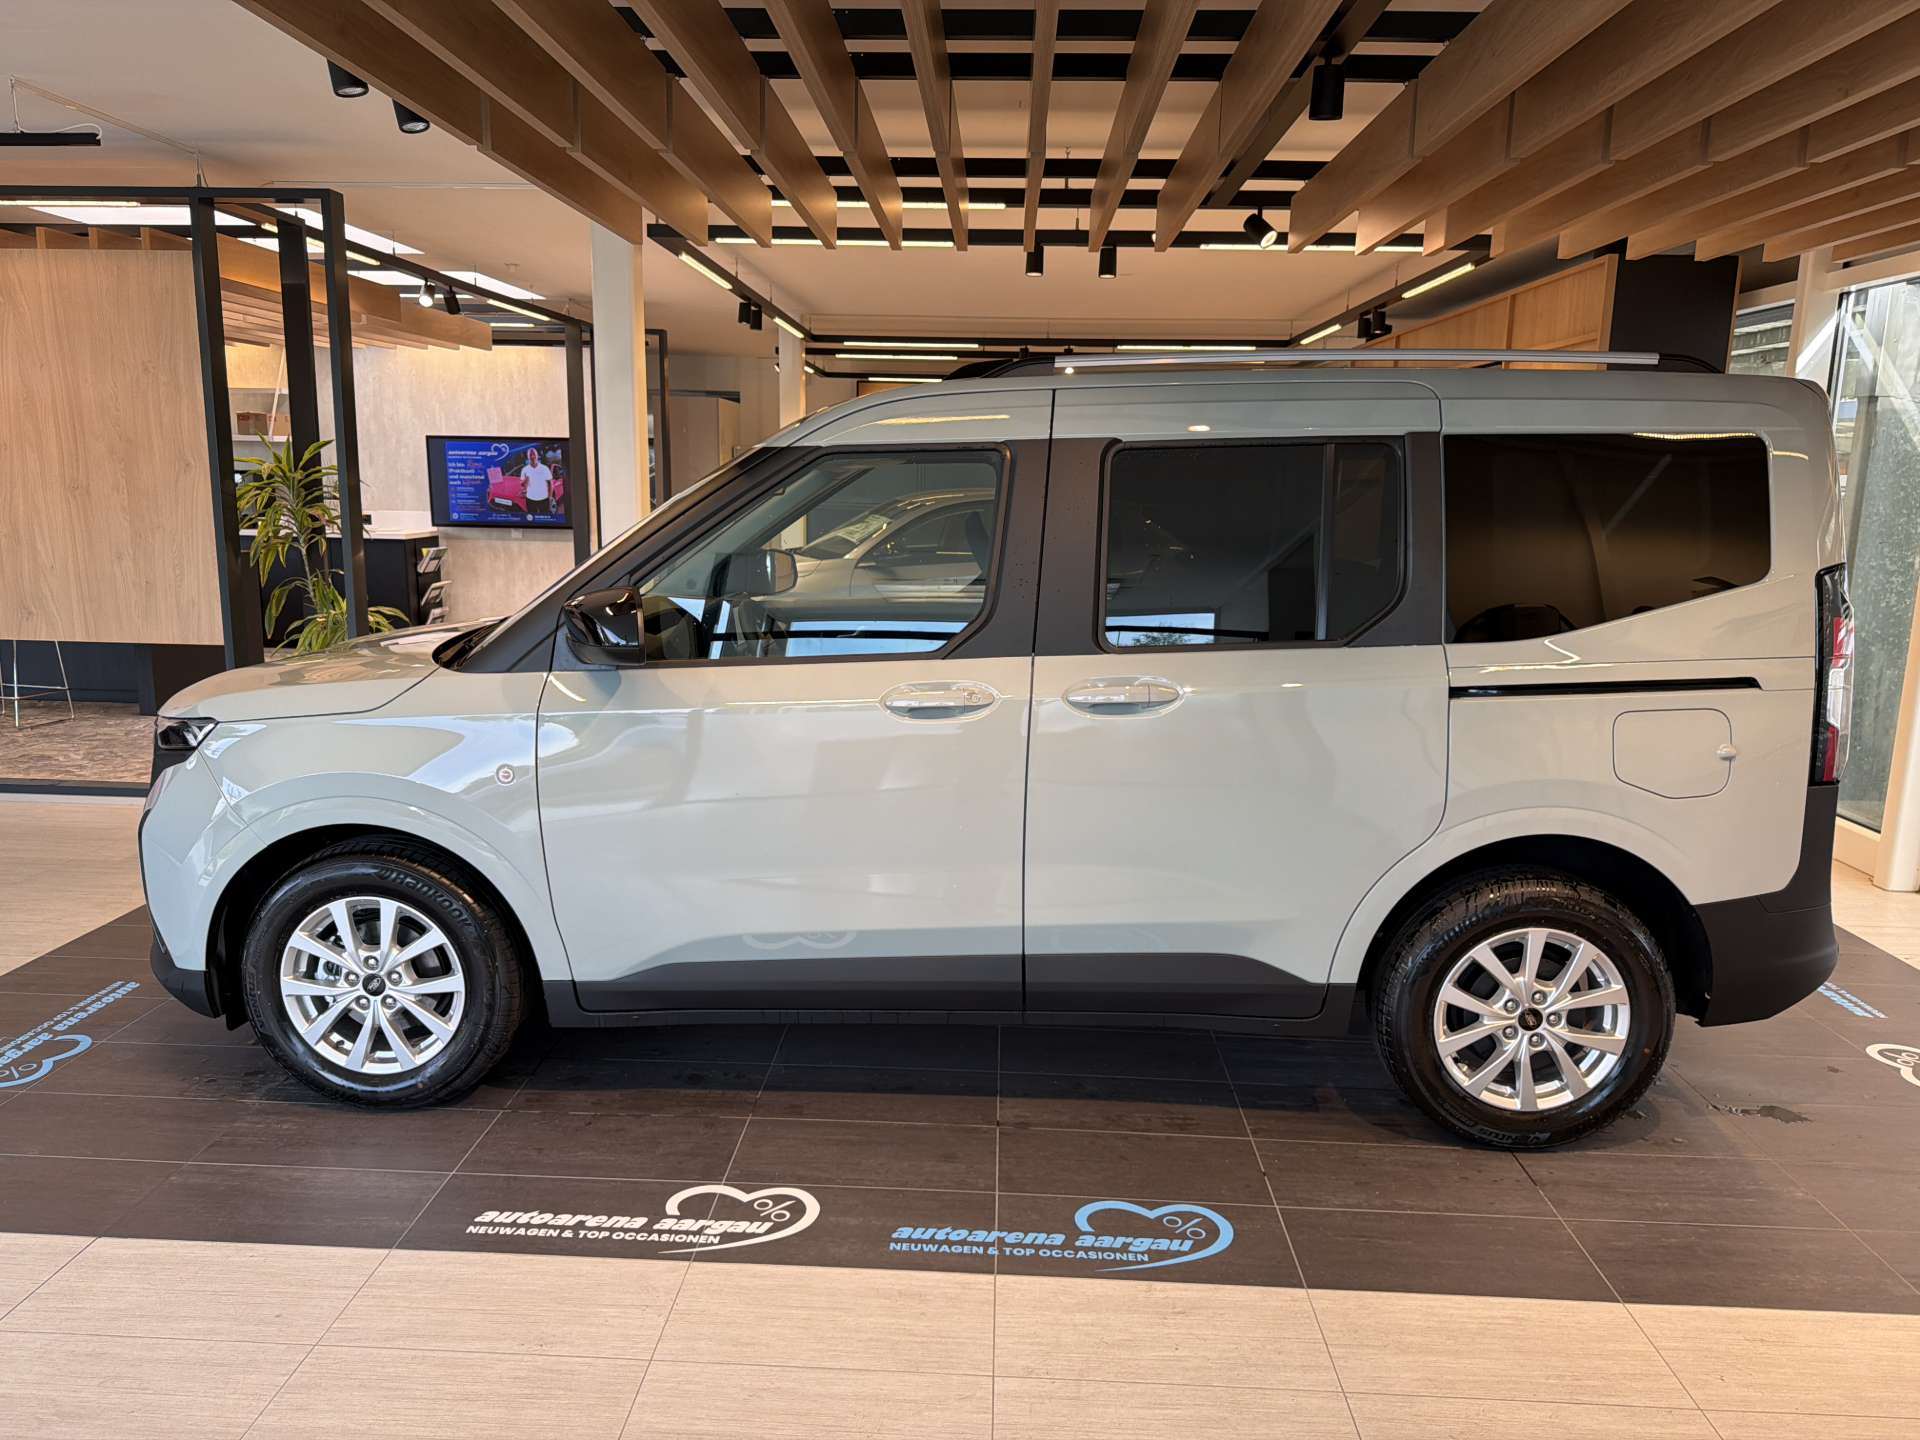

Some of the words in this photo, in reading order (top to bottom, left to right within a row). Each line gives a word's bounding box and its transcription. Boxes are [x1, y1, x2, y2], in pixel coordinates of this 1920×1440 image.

[51, 981, 140, 1031] autoarena
[465, 1225, 561, 1239] NEUWAGEN
[561, 1230, 574, 1239] &
[577, 1230, 611, 1241] TOP
[612, 1231, 721, 1245] OCCASIONEN
[473, 1209, 649, 1230] autoarena
[652, 1216, 774, 1235] aargau
[890, 1225, 1066, 1247] autoarena
[1074, 1233, 1194, 1252] aargau
[888, 1242, 984, 1256] NEUWAGEN
[987, 1246, 998, 1256] &
[1002, 1246, 1036, 1258] TOP
[1038, 1248, 1149, 1262] OCCASIONEN
